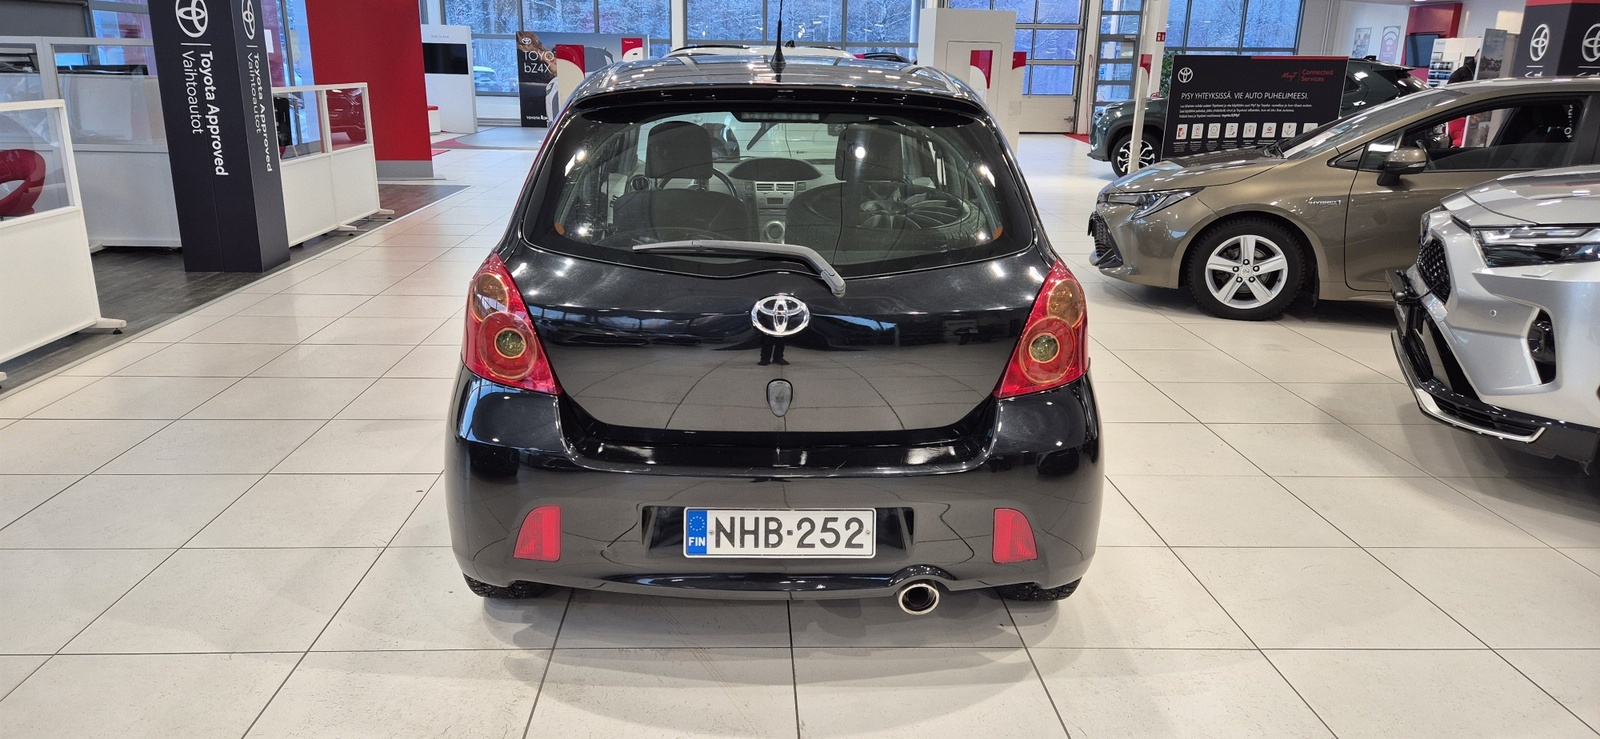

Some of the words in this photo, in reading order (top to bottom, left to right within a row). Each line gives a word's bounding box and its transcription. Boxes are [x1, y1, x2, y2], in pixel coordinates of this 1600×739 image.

[199, 51, 216, 100] Toyota
[523, 50, 556, 61] TOYO
[523, 63, 552, 74] bZ4X
[182, 50, 204, 135] Vaihtoautot
[247, 52, 262, 134] Vaihtoautot
[253, 53, 263, 100] Toyota
[259, 104, 273, 172] Approved
[1181, 92, 1193, 100] PYSY
[1195, 91, 1232, 100] YHTEYKSISSÄ.
[1234, 92, 1243, 100] VIE
[1244, 92, 1263, 100] AUTO
[1264, 92, 1309, 100] PUHELIMEESI.
[205, 104, 229, 176] Approved
[688, 537, 706, 547] FIN
[715, 516, 865, 549] NHB-252
